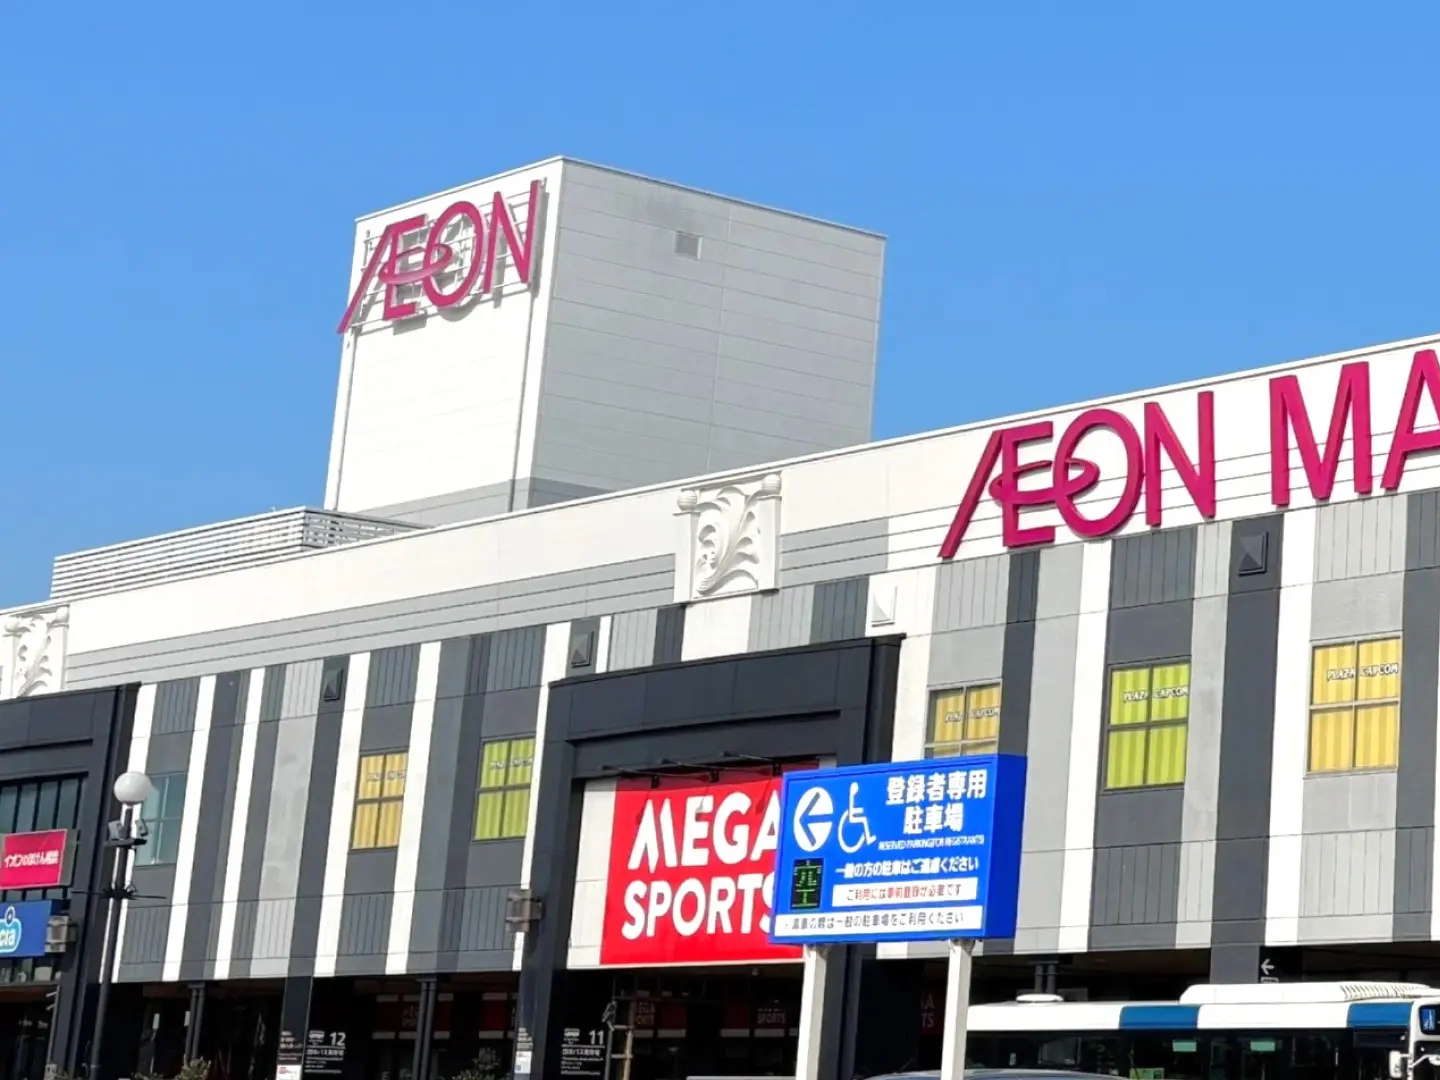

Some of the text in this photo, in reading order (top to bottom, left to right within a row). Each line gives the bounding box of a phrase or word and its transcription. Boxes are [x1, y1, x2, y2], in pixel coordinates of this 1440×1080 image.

[1360, 663, 1399, 677] CAPCOM
[886, 769, 987, 805] 登録者専用
[903, 802, 964, 834] 駐車場
[627, 790, 781, 874] MEGA
[330, 1032, 346, 1046] 12
[589, 1030, 604, 1045] 11
